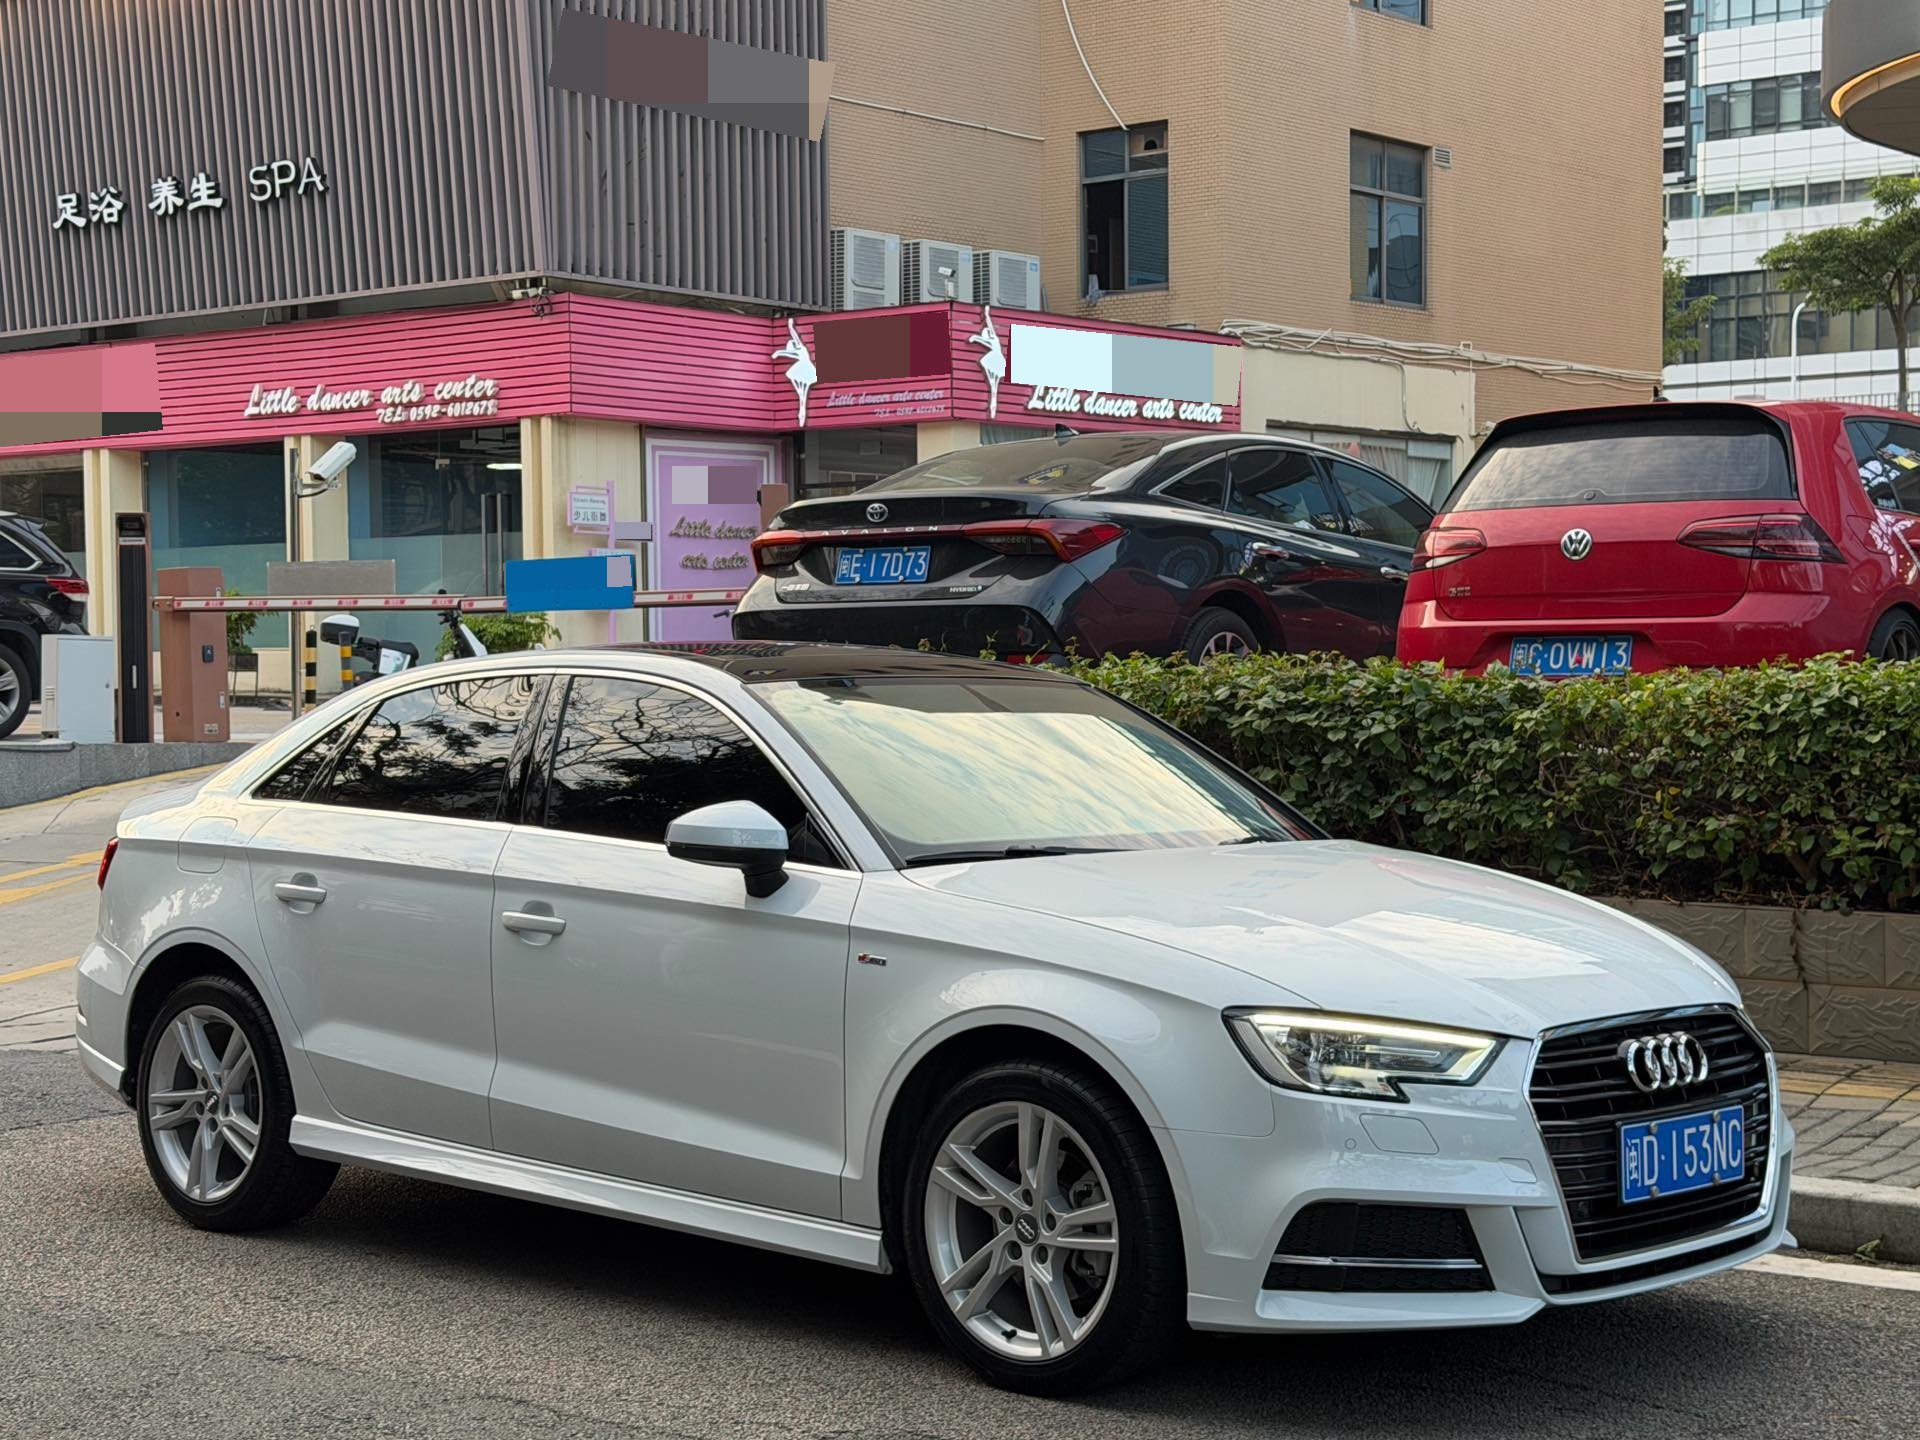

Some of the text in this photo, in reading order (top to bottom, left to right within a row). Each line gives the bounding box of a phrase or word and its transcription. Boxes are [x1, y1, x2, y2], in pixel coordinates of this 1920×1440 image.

[53, 156, 327, 229] 足浴 养生 SPA
[244, 374, 499, 416] Little dancer arts center
[1027, 385, 1223, 424] Little dancer arts center
[669, 515, 712, 538] Little
